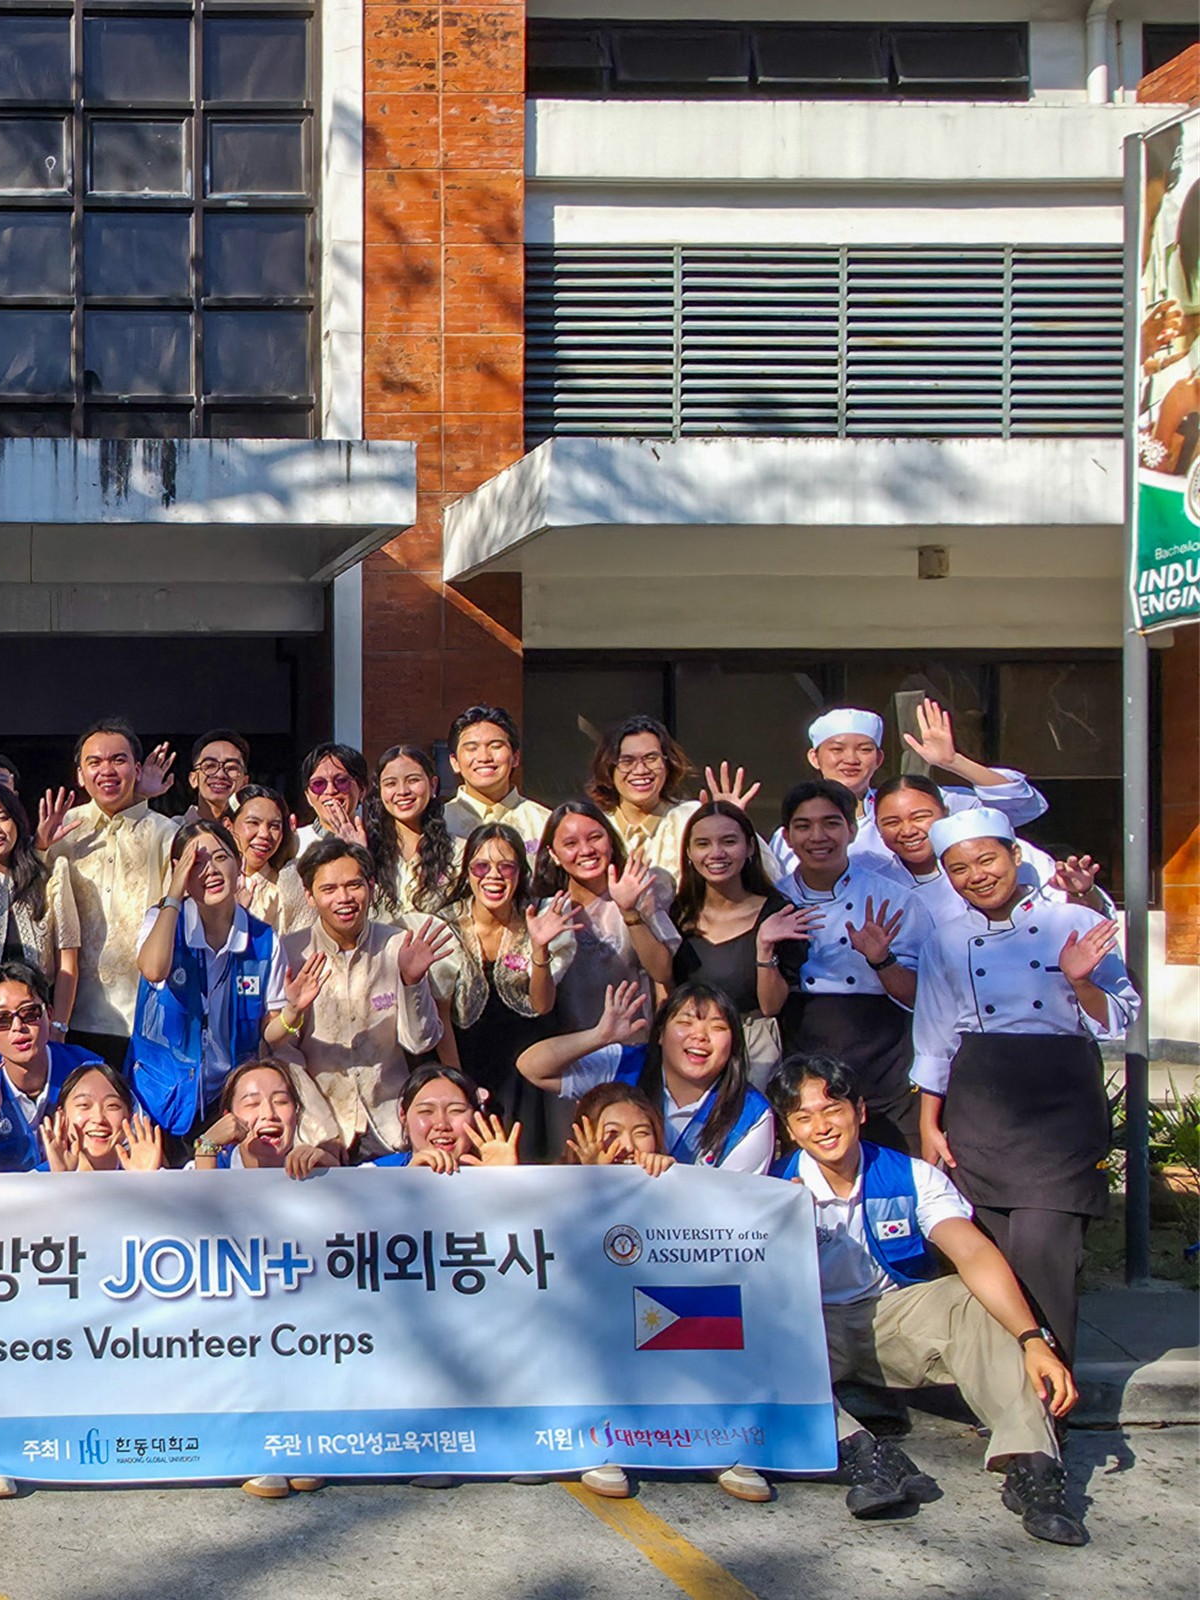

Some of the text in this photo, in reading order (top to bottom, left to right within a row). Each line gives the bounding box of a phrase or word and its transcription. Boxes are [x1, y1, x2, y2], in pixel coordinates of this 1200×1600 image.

[1139, 558, 1200, 594] INDU
[645, 1229, 769, 1241] UNIVERSITY of the
[101, 1235, 312, 1297] JOIN+
[325, 1229, 555, 1294] 해외봉사
[647, 1247, 766, 1263] ASSUMPTION
[83, 1326, 262, 1360] Volunteer
[270, 1325, 374, 1365] Corps
[22, 1438, 59, 1463] 주최
[115, 1436, 200, 1457] 한동대학교
[263, 1434, 301, 1457] 주관
[318, 1430, 477, 1455] RC인성교육지원팀
[535, 1428, 574, 1450] 지원
[615, 1426, 765, 1448] 대학혁신지원사업
